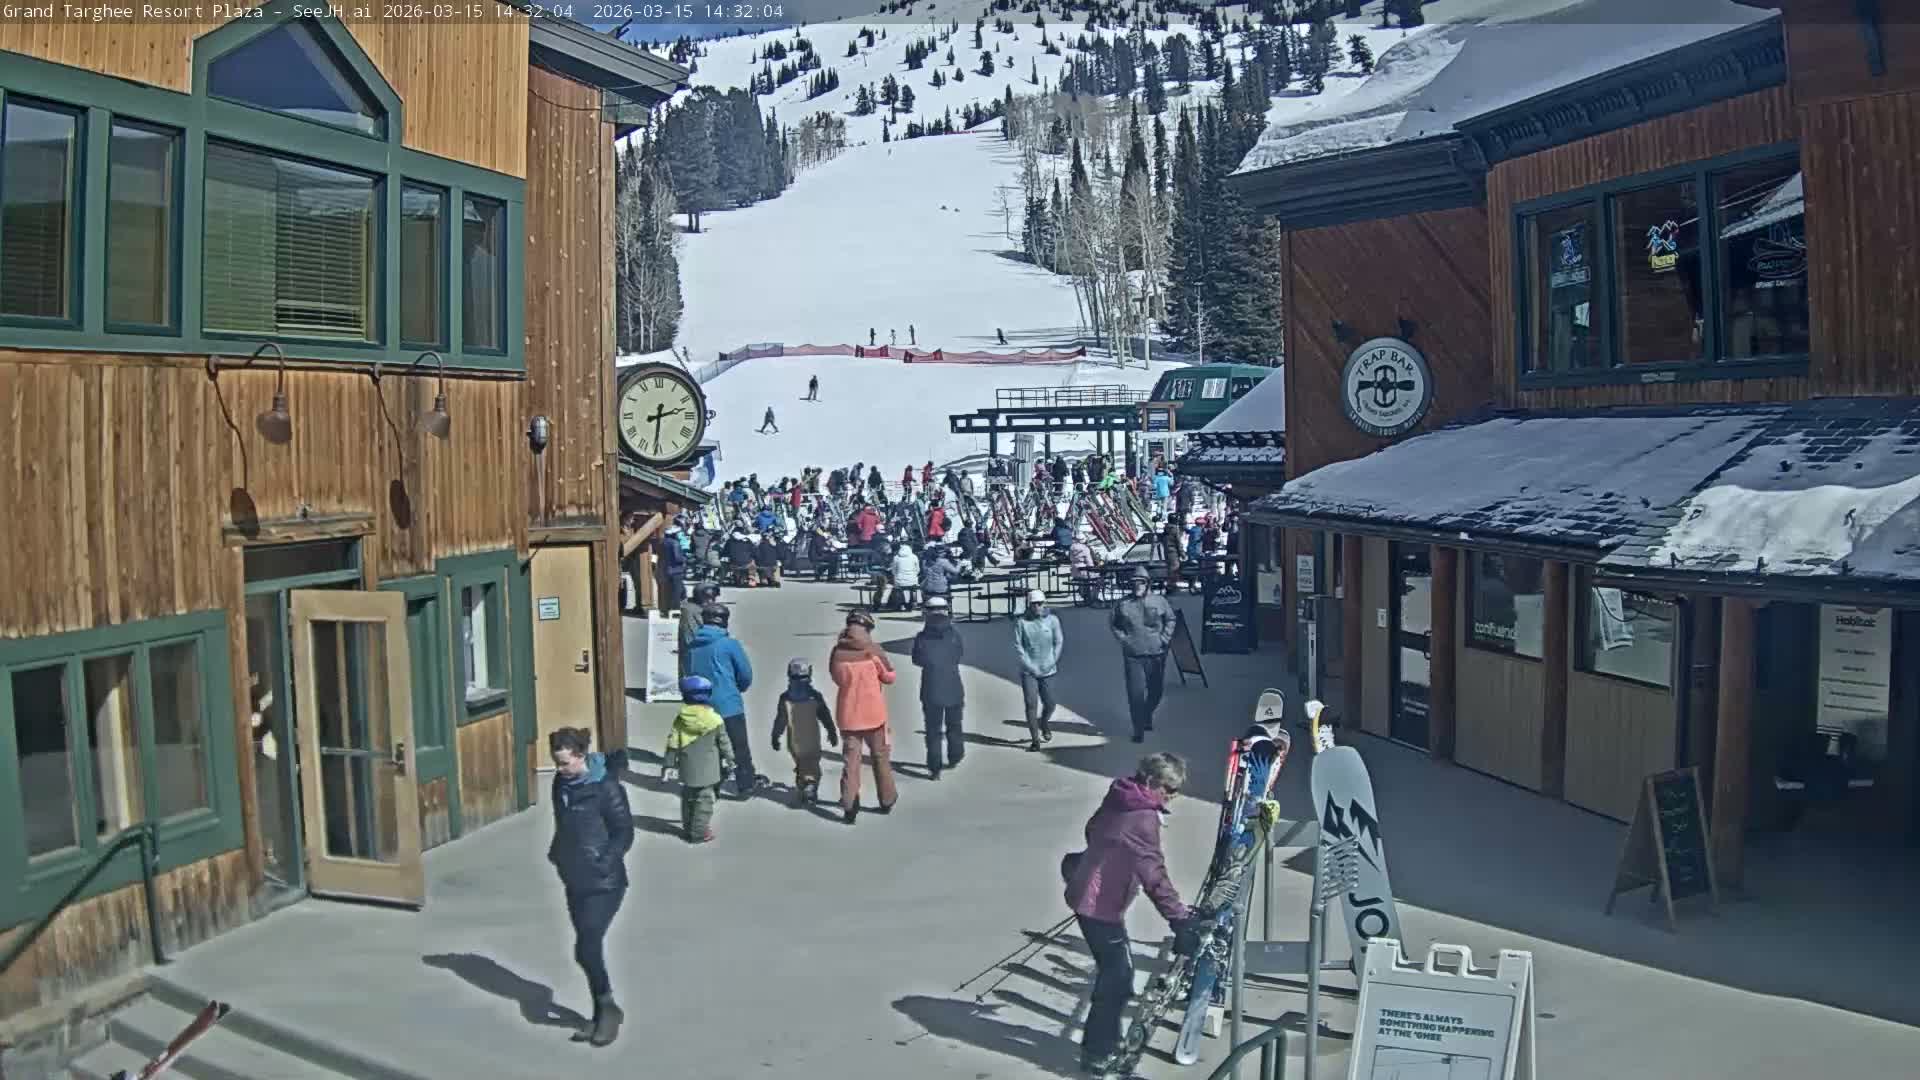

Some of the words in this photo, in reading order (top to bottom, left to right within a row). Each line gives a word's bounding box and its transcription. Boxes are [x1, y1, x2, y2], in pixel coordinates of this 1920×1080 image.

[1356, 349, 1387, 377] TRAP
[1390, 350, 1415, 376] BAR
[1380, 1008, 1422, 1021] THERE'S
[1423, 1013, 1464, 1025] ALWAYS
[1378, 1027, 1393, 1036] AT
[1394, 1028, 1413, 1038] THE
[1379, 1018, 1437, 1031] SOMETHING
[1438, 1024, 1496, 1038] HAPPENING
